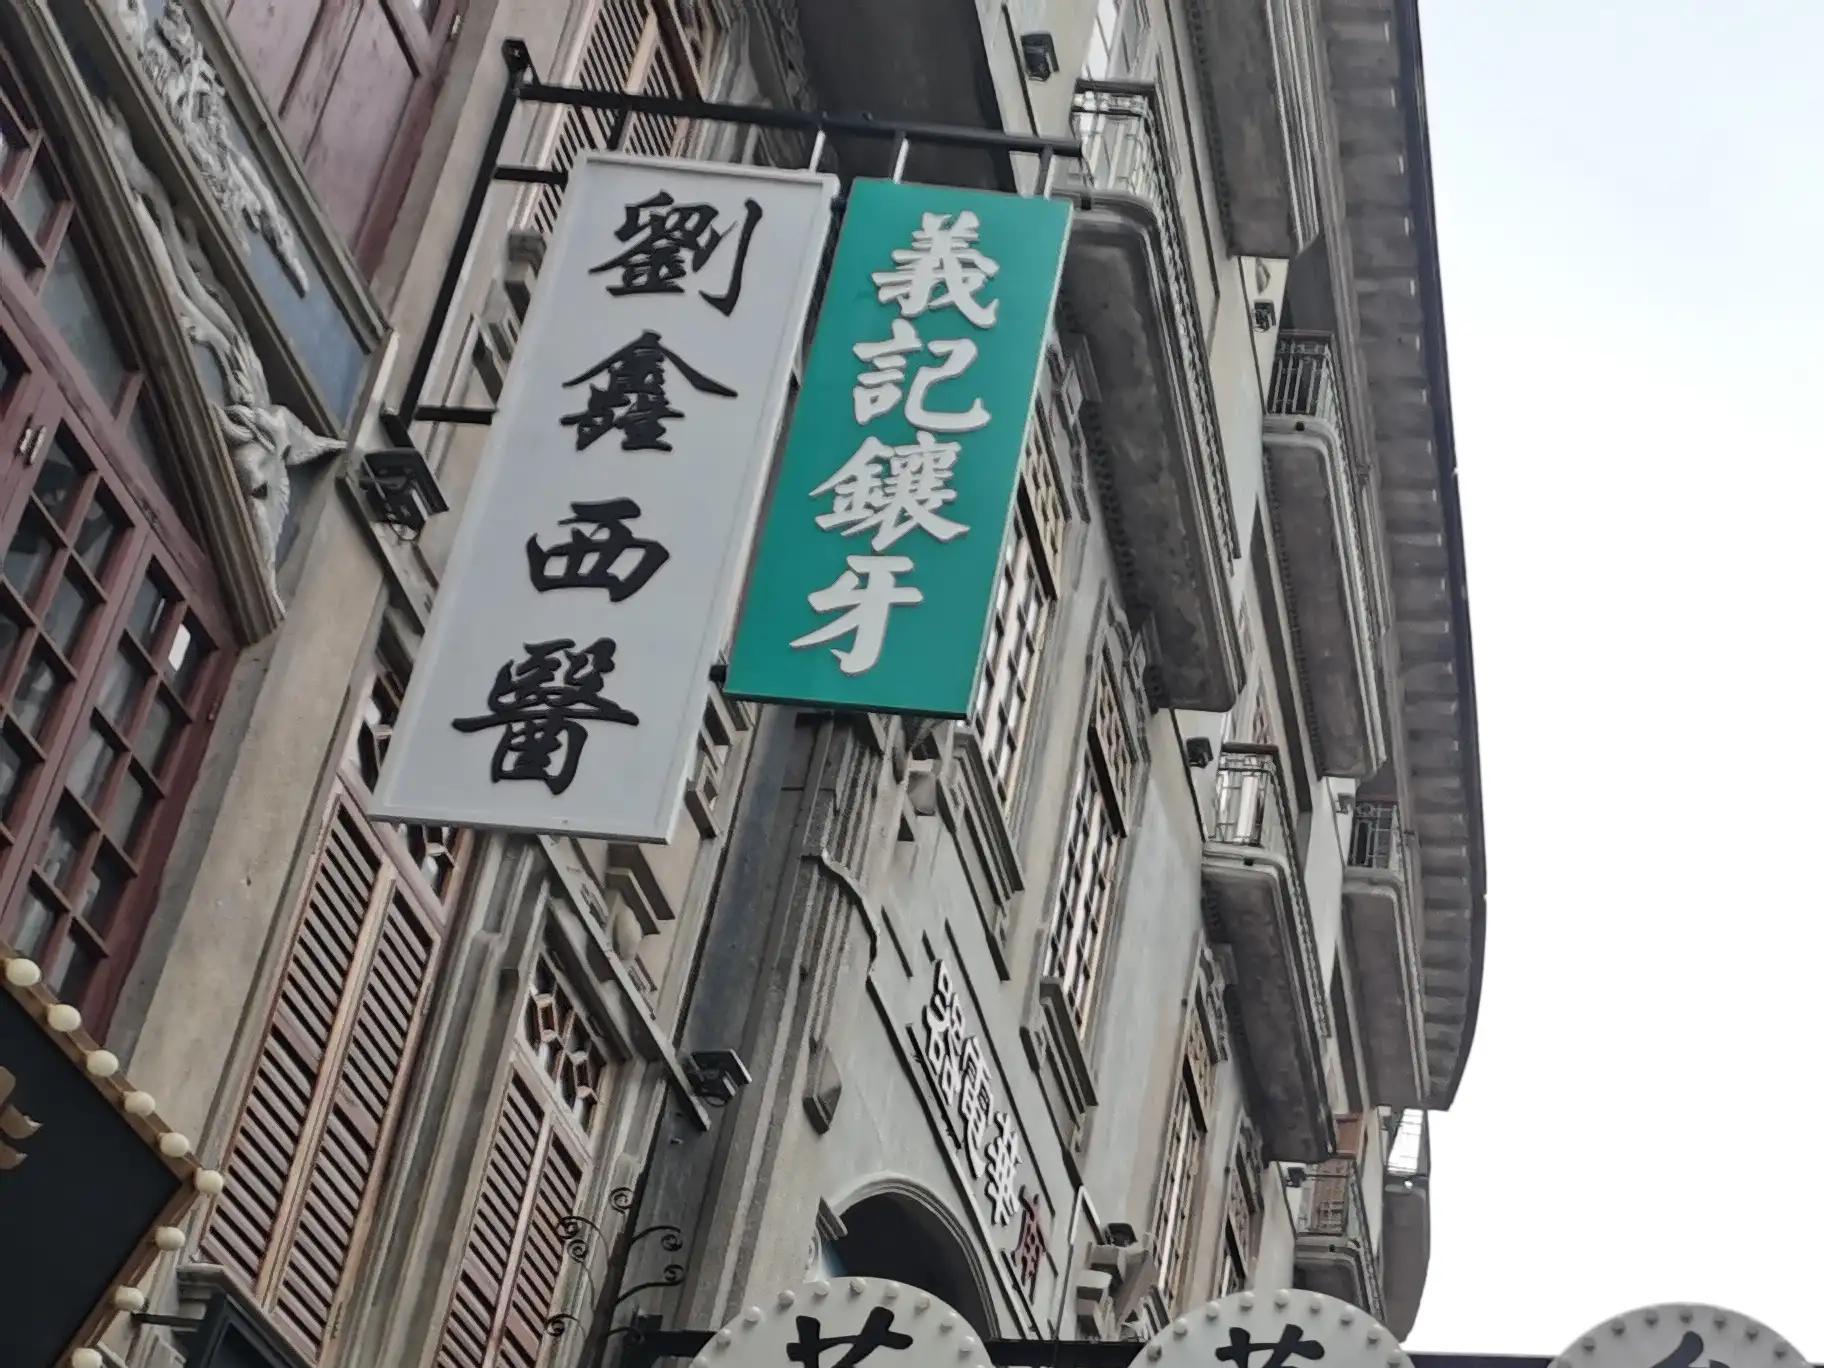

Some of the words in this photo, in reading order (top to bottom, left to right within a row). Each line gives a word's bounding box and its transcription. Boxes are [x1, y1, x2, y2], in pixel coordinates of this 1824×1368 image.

[452, 190, 766, 796] 劉鑫西醫
[789, 209, 1001, 677] 義記鑲牙
